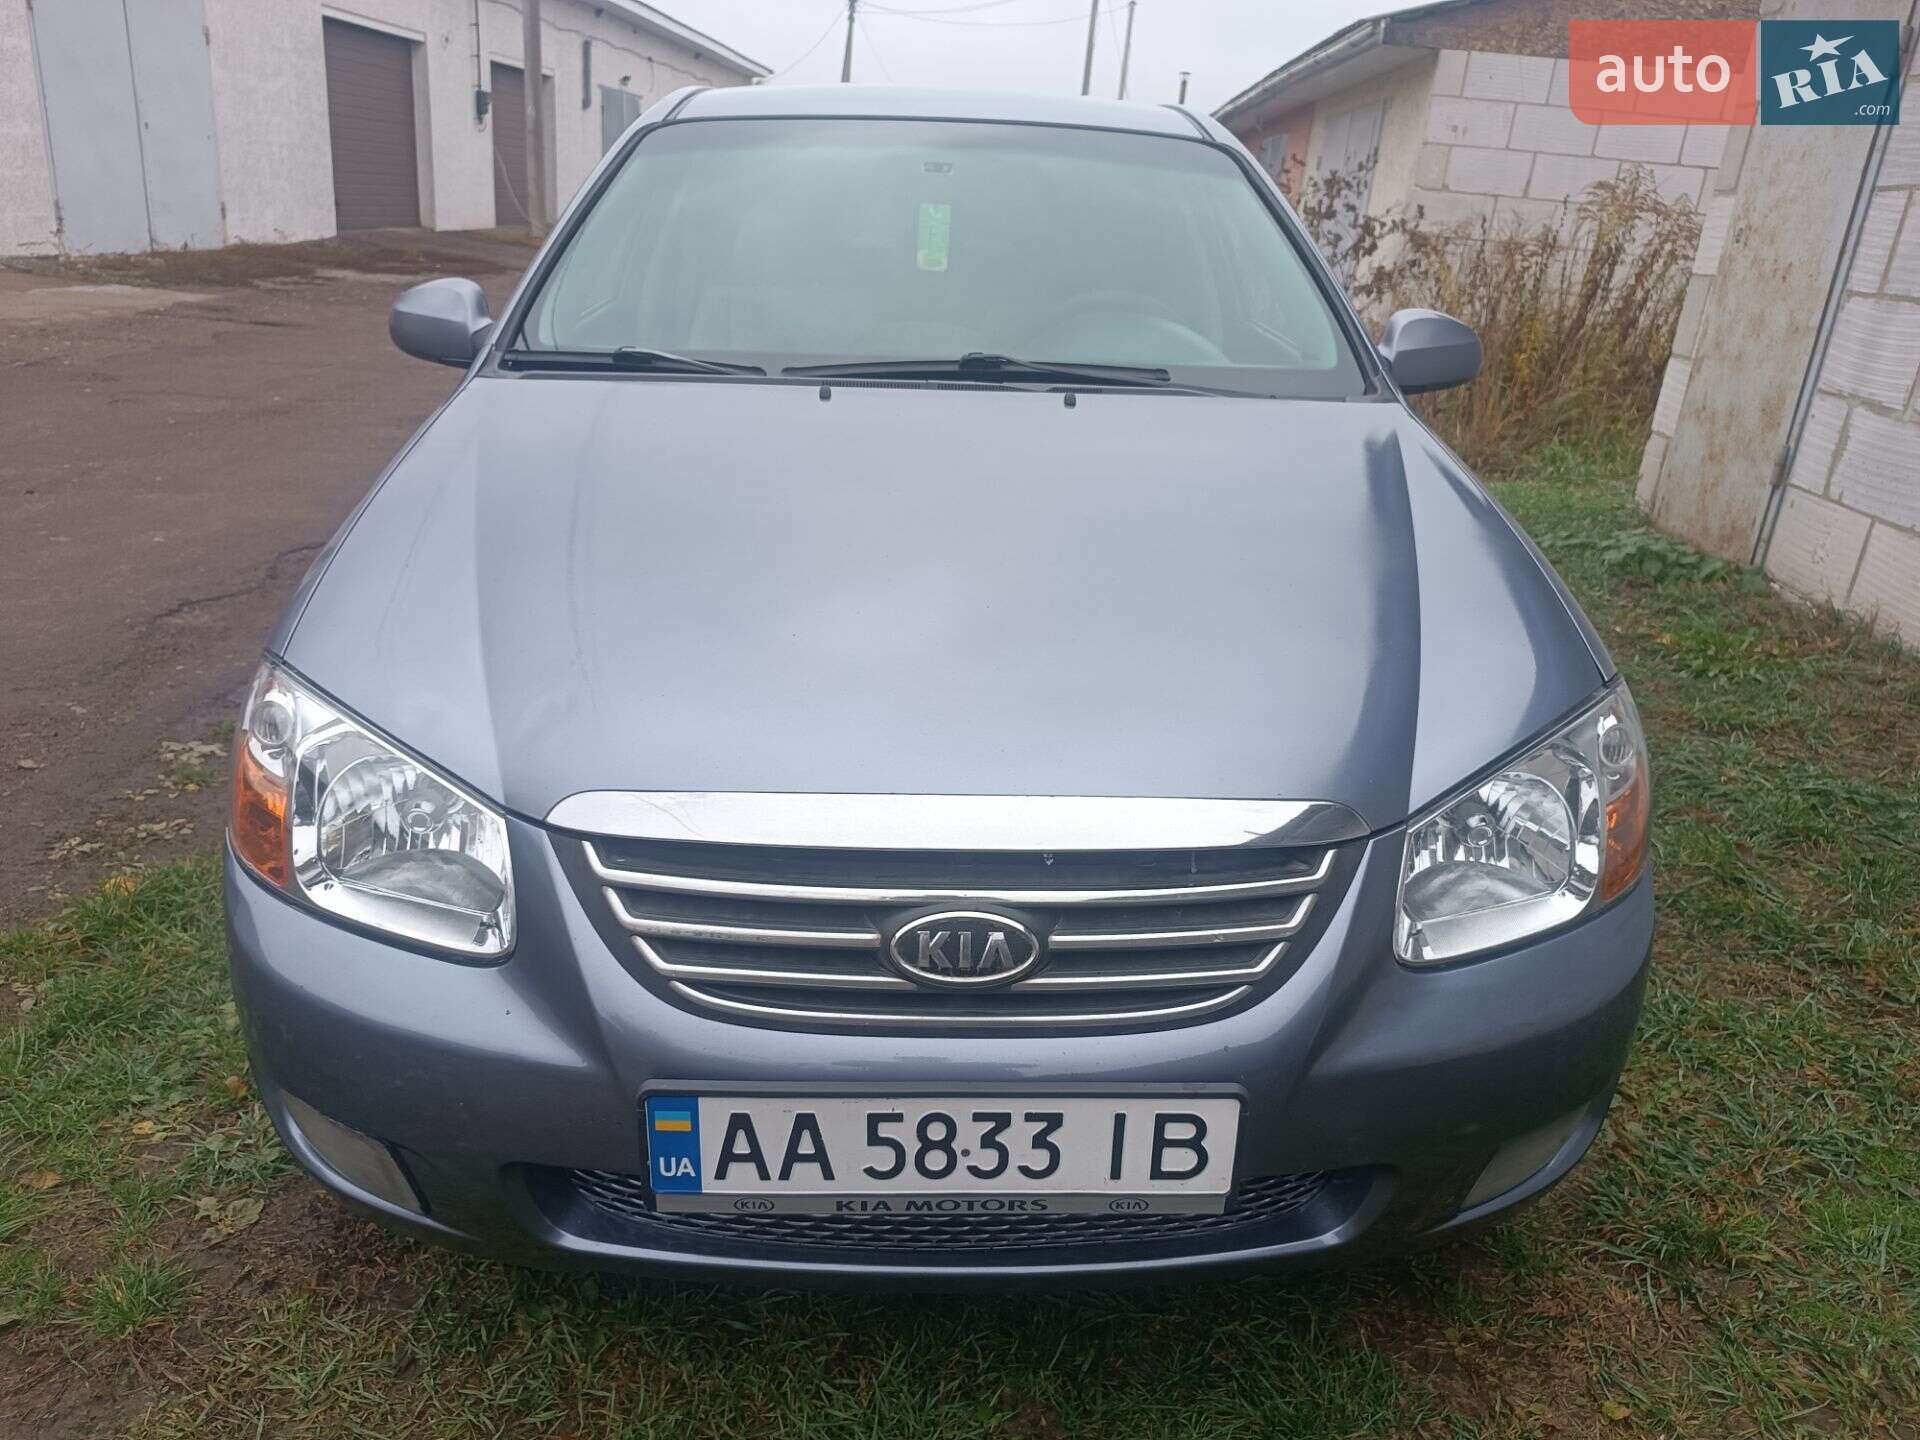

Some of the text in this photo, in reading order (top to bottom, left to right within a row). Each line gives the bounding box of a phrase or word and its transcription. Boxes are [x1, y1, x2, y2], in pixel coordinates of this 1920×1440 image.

[917, 930, 1016, 969] KIA
[714, 1112, 1209, 1181] AA 5833 IB
[659, 1157, 696, 1177] UA
[740, 1201, 769, 1210] KIA
[835, 1200, 1049, 1212] KIA MOTORS
[1115, 1201, 1143, 1210] KIA
